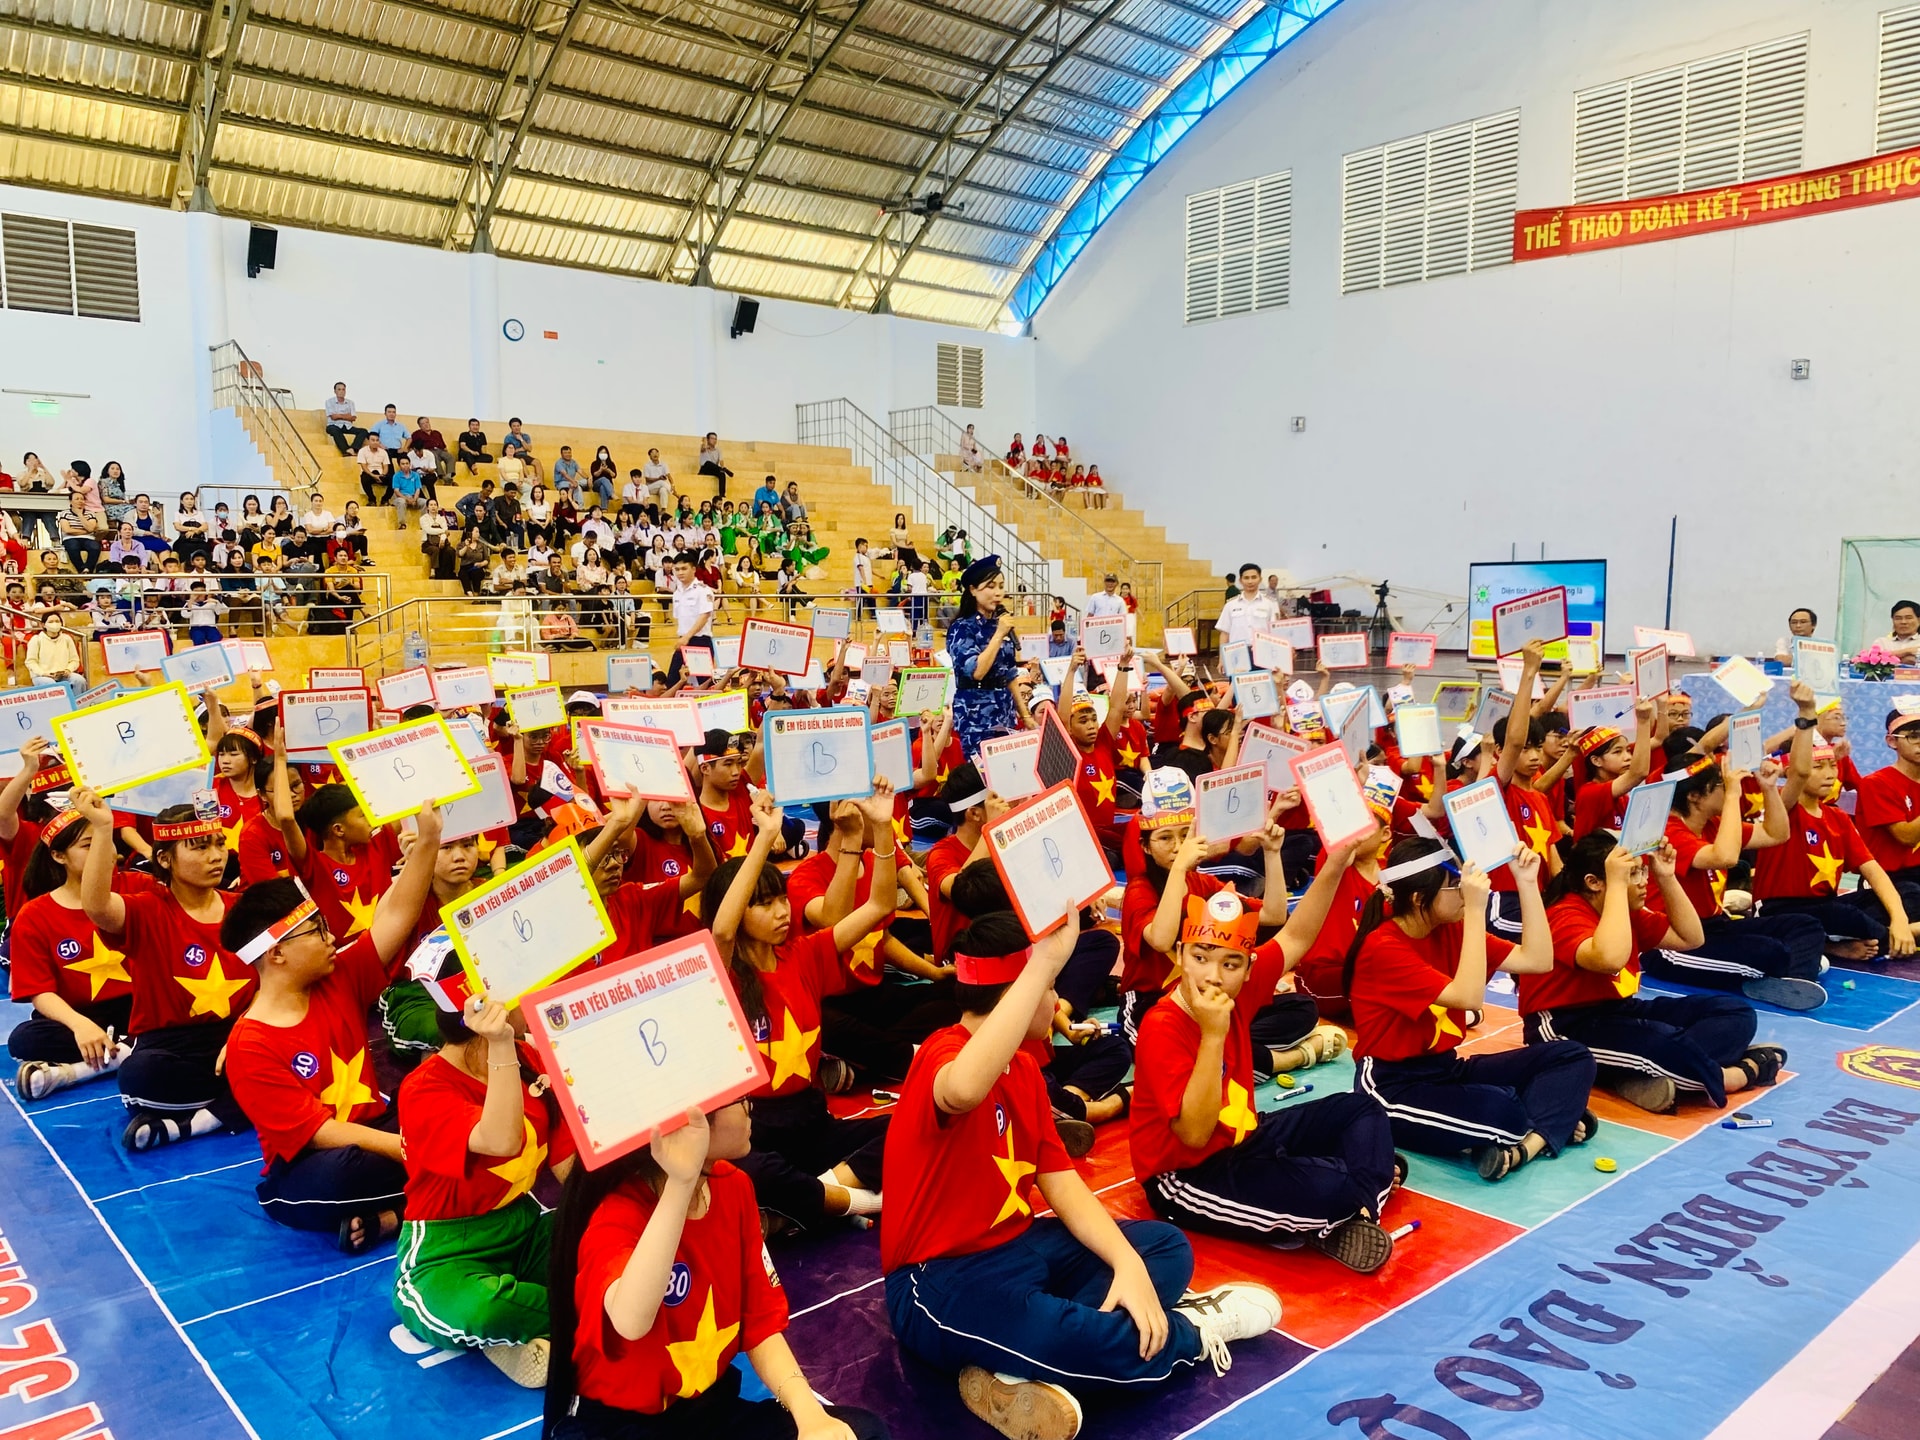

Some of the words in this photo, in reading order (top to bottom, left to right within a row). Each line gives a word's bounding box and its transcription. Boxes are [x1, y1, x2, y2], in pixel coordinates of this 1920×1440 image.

[1524, 210, 1564, 250] THỂ
[1569, 212, 1623, 244] THAO
[1629, 200, 1689, 234] ĐOÀN
[1696, 188, 1750, 220] KẾT,
[1757, 174, 1841, 212] TRUNG
[1848, 157, 1920, 195] THỰC
[768, 639, 776, 654] B
[1100, 629, 1111, 645] B
[917, 686, 928, 700] B
[1252, 686, 1262, 704] B
[16, 711, 32, 730] B
[316, 706, 340, 736] B
[786, 721, 795, 731] EM
[797, 719, 806, 731] YÊU
[835, 717, 844, 728] QUÊ
[846, 717, 863, 727] HƯƠNG
[116, 721, 135, 744] B
[356, 747, 368, 757] EM
[812, 742, 837, 775] B
[393, 757, 416, 782] B
[477, 762, 496, 774] HƯƠNG
[632, 754, 644, 773] B
[1086, 766, 1096, 774] 25
[1227, 787, 1240, 814] B
[159, 828, 169, 837] TẤT
[171, 826, 182, 836] CẢ
[184, 825, 192, 834] VÌ
[194, 821, 213, 832] BIỂN
[214, 820, 222, 830] ĐẢ
[712, 824, 722, 833] 47
[1159, 813, 1179, 826] BIỂN
[1180, 812, 1193, 823] ĐẢ
[1005, 828, 1016, 842] EM
[1043, 838, 1063, 878] B
[665, 862, 679, 874] 43
[334, 872, 348, 884] 49
[473, 903, 487, 919] EM
[487, 895, 501, 911] YÊU
[500, 885, 521, 903] BIỂN,
[520, 875, 535, 892] ĐẢO
[534, 865, 549, 883] QUÊ
[548, 854, 572, 875] HƯƠNG
[513, 910, 533, 943] B
[1186, 923, 1232, 942] THÂN
[60, 941, 78, 956] 50
[186, 948, 204, 964] 45
[569, 1000, 589, 1020] EM
[589, 992, 609, 1012] YÊU
[608, 980, 637, 1005] BIỂN,
[635, 972, 656, 994] ĐẢO
[656, 964, 676, 987] QUÊ
[675, 955, 708, 979] HƯƠNG
[639, 1019, 666, 1066] B
[296, 1054, 313, 1078] 40
[1806, 1098, 1920, 1146] EM
[1725, 1138, 1872, 1208] YÊU
[1558, 1194, 1790, 1299] BIỂN,
[1434, 1290, 1646, 1412] ĐẢO
